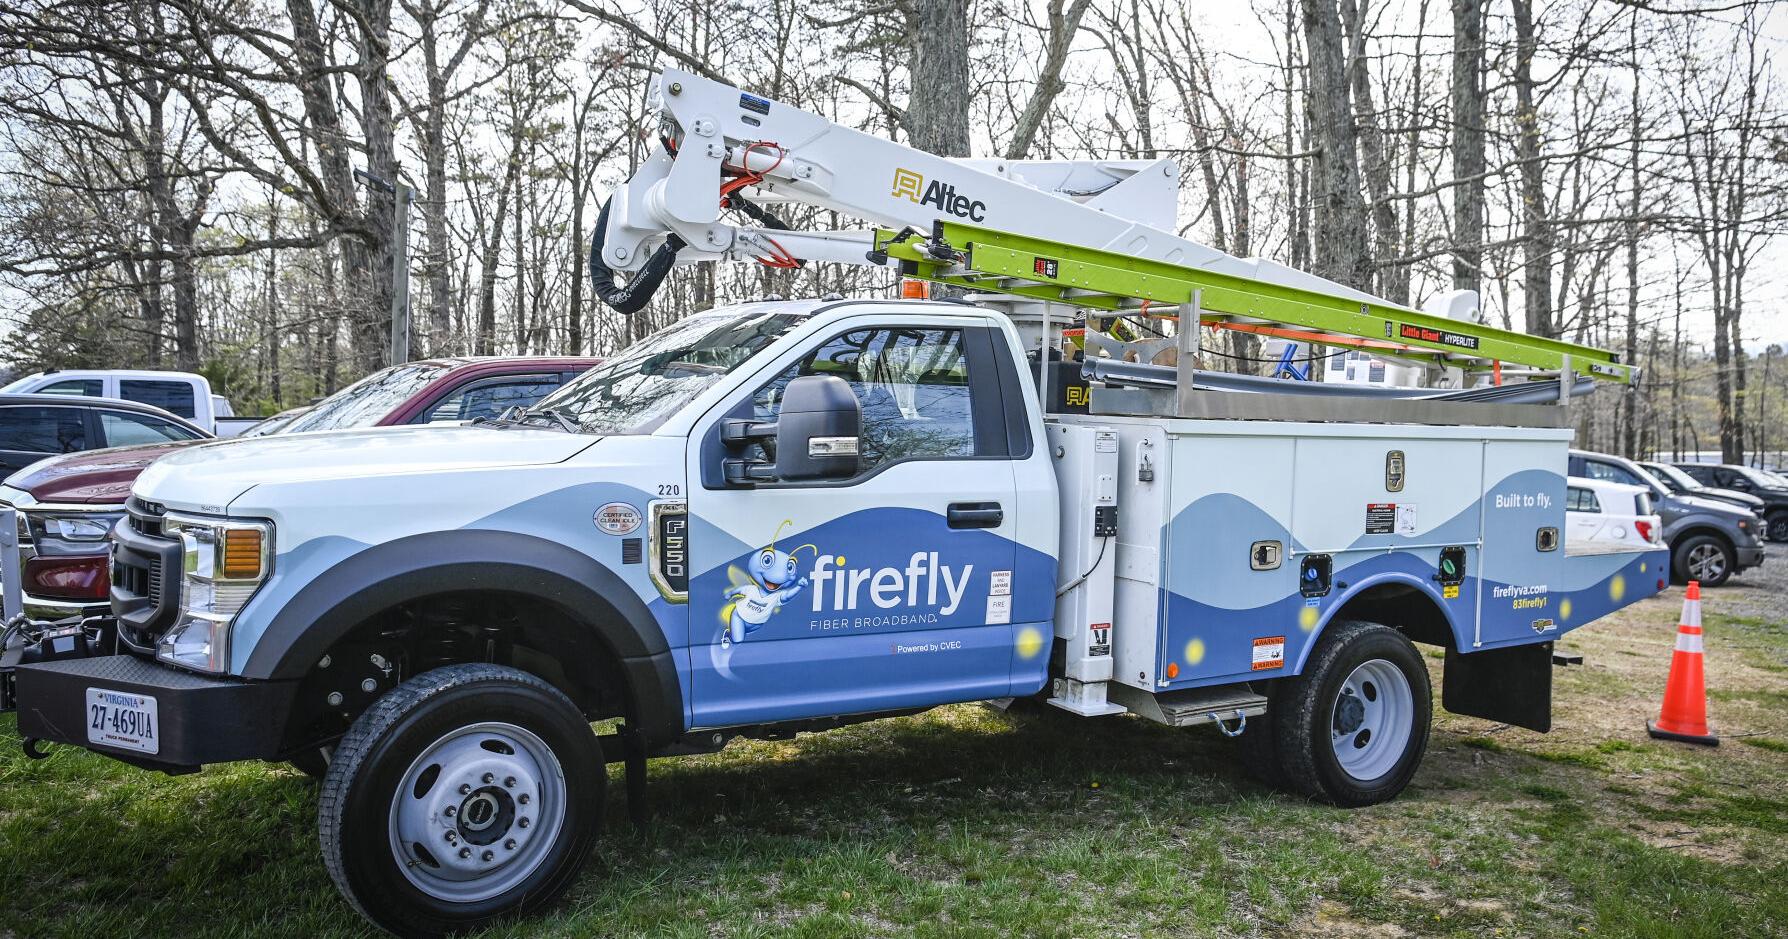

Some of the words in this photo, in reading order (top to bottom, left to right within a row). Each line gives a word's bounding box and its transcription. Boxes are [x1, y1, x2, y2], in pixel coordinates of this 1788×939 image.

[920, 179, 986, 222] Altec
[1401, 325, 1420, 338] Little
[1421, 329, 1440, 342] Giant
[1444, 334, 1475, 347] HYPERLITE
[658, 484, 680, 496] 220
[1495, 493, 1521, 508] Built
[1523, 494, 1535, 507] to
[1536, 492, 1552, 509] fly.
[809, 551, 974, 616] firefly
[1493, 584, 1548, 598] fireflyva.com
[1512, 597, 1547, 610] 83firefly1
[810, 618, 849, 631] FIBER
[897, 643, 928, 654] Powered
[930, 643, 939, 652] by
[940, 641, 961, 650] CVEC
[104, 693, 139, 708] VIRGINIA
[91, 704, 153, 739] 27-469UA
